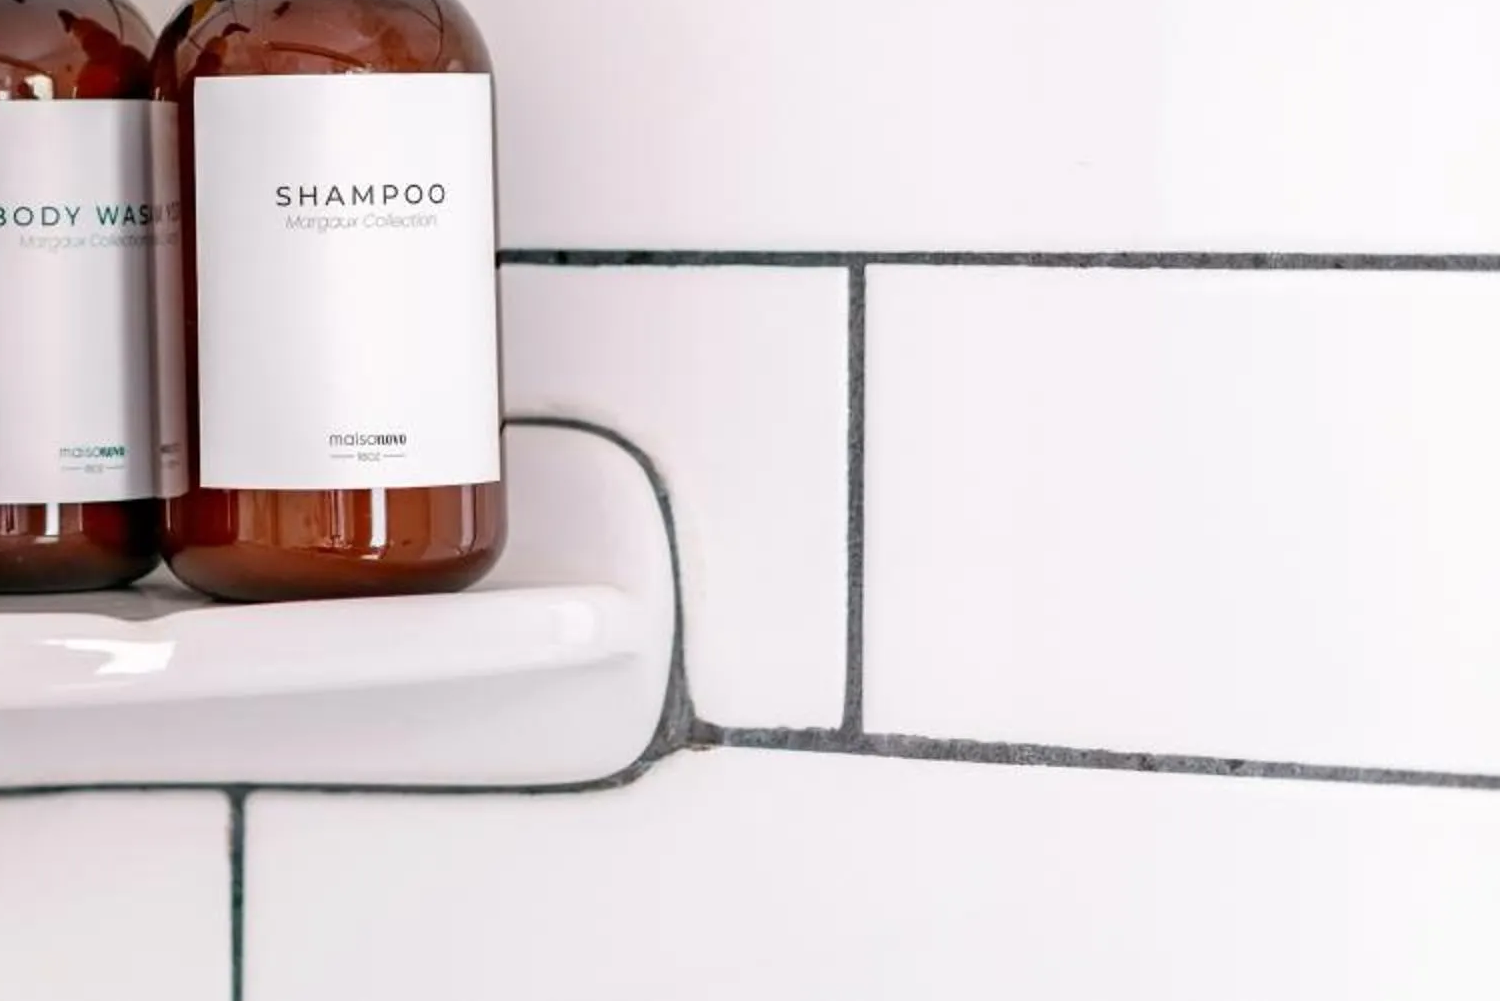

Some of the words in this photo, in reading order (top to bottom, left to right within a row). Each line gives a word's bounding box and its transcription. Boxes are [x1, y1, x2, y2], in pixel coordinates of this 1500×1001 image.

[276, 183, 446, 207] SHAMPOO
[96, 205, 152, 226] WAS
[285, 214, 358, 233] Margaux
[362, 212, 438, 229] Collection
[329, 432, 407, 447] maisonovo
